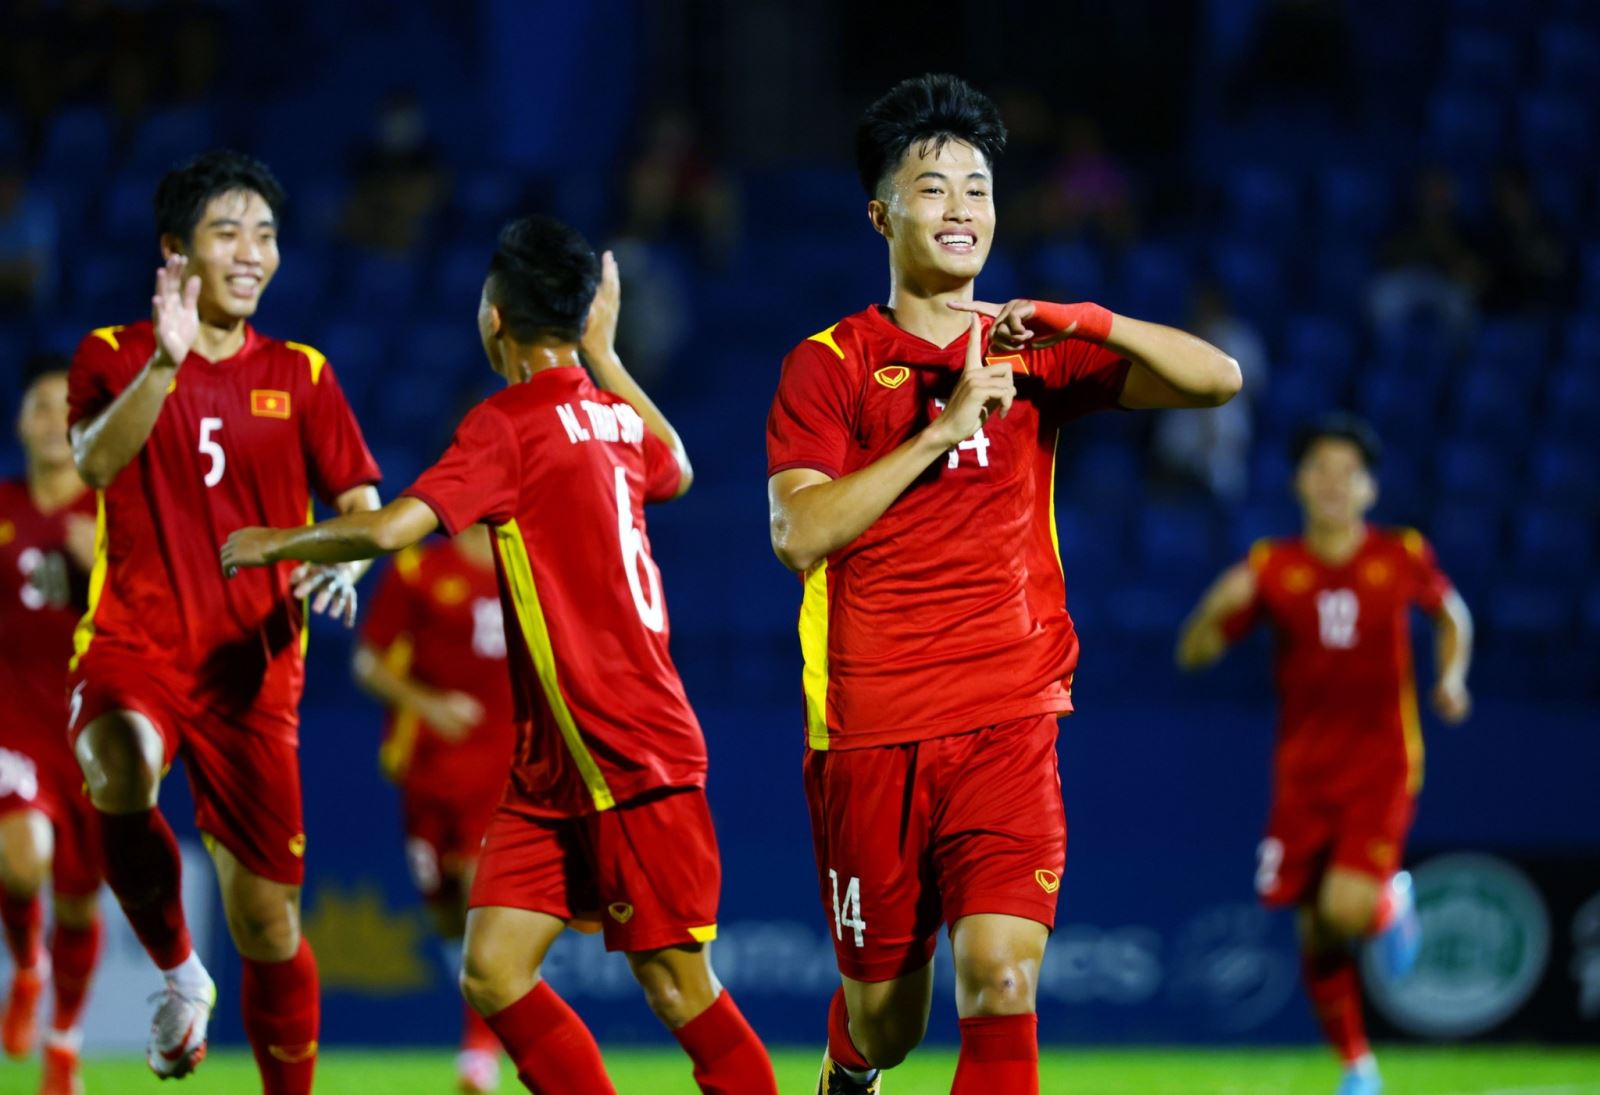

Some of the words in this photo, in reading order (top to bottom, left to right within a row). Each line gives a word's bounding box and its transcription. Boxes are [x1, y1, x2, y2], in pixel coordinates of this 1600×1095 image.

[199, 417, 226, 487] 5
[615, 466, 664, 632] 6
[829, 868, 866, 947] 14
